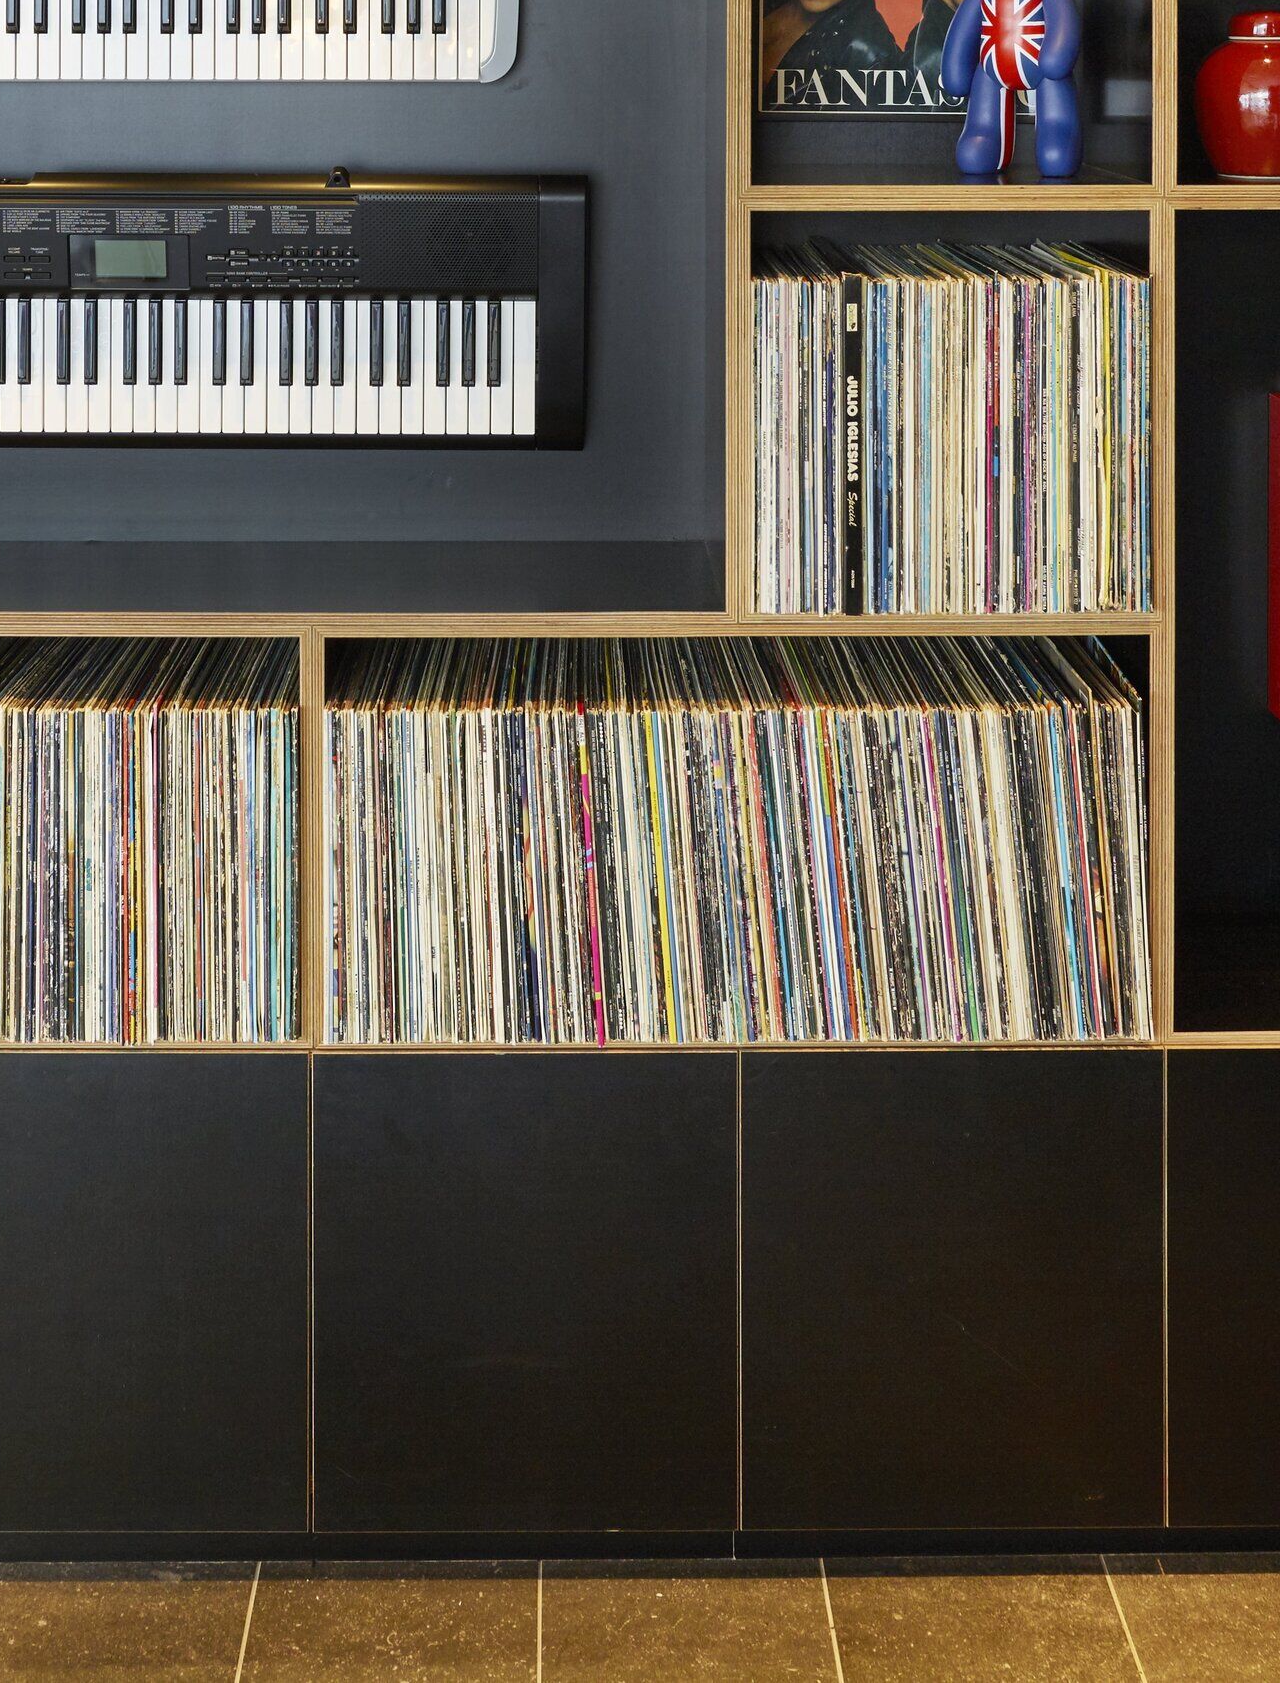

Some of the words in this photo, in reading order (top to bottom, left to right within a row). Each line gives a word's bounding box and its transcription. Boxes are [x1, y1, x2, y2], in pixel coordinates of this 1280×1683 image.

[769, 69, 965, 107] FANTAS
[846, 376, 858, 416] JULIO
[846, 422, 858, 482] IGLESIAS
[846, 492, 858, 527] Special
